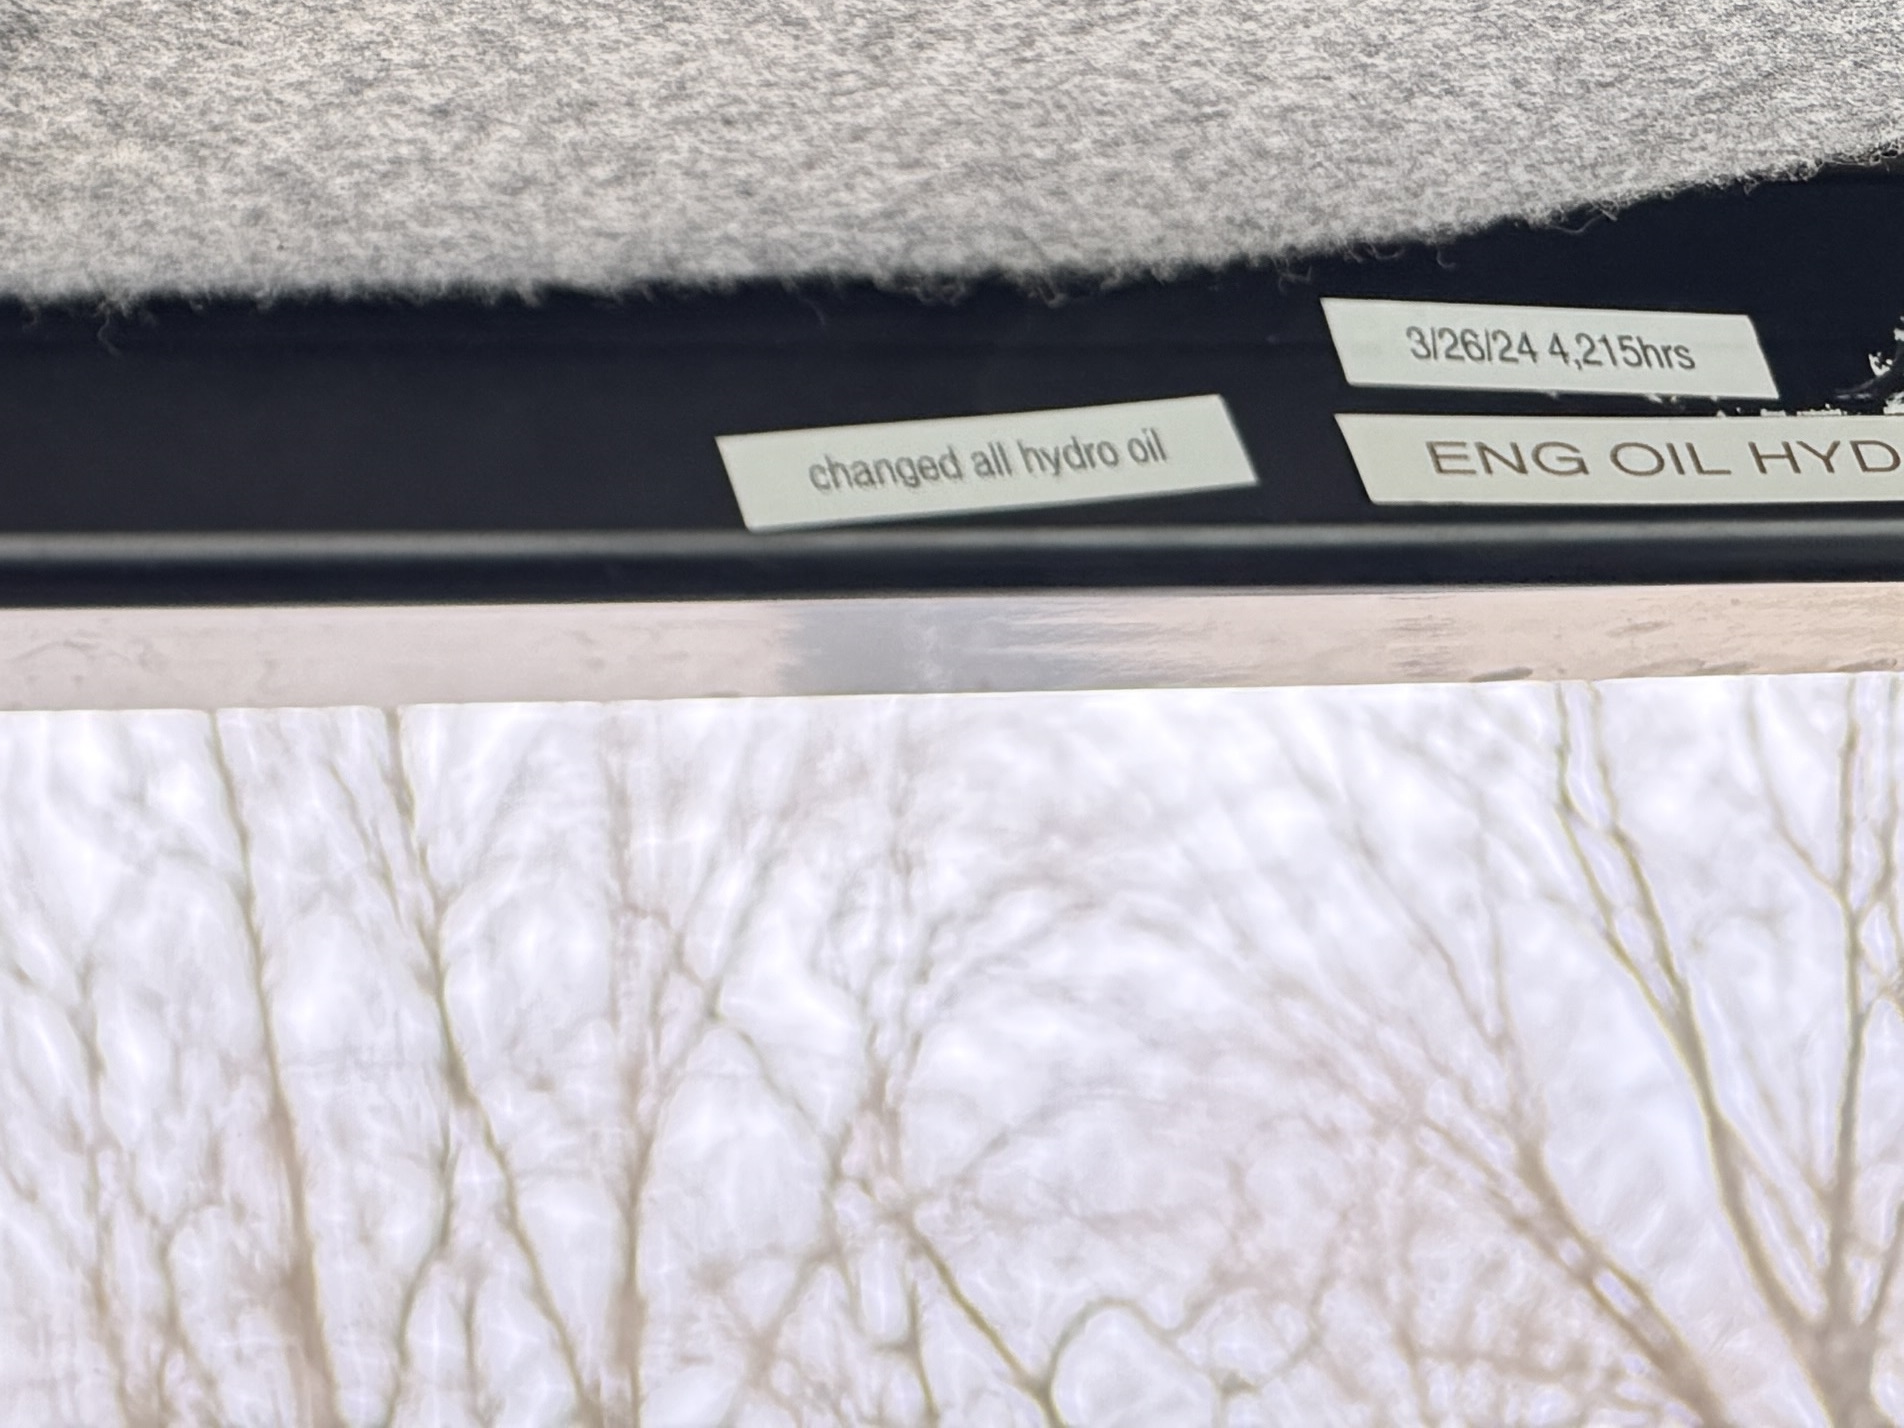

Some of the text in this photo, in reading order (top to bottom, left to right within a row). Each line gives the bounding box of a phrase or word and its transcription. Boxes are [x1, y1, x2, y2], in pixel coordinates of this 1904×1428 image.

[1405, 325, 1696, 372] 3/26/24 4,215hrs
[808, 427, 1169, 492] changed all hydro oil
[1425, 440, 1903, 477] ENG OIL HYD
